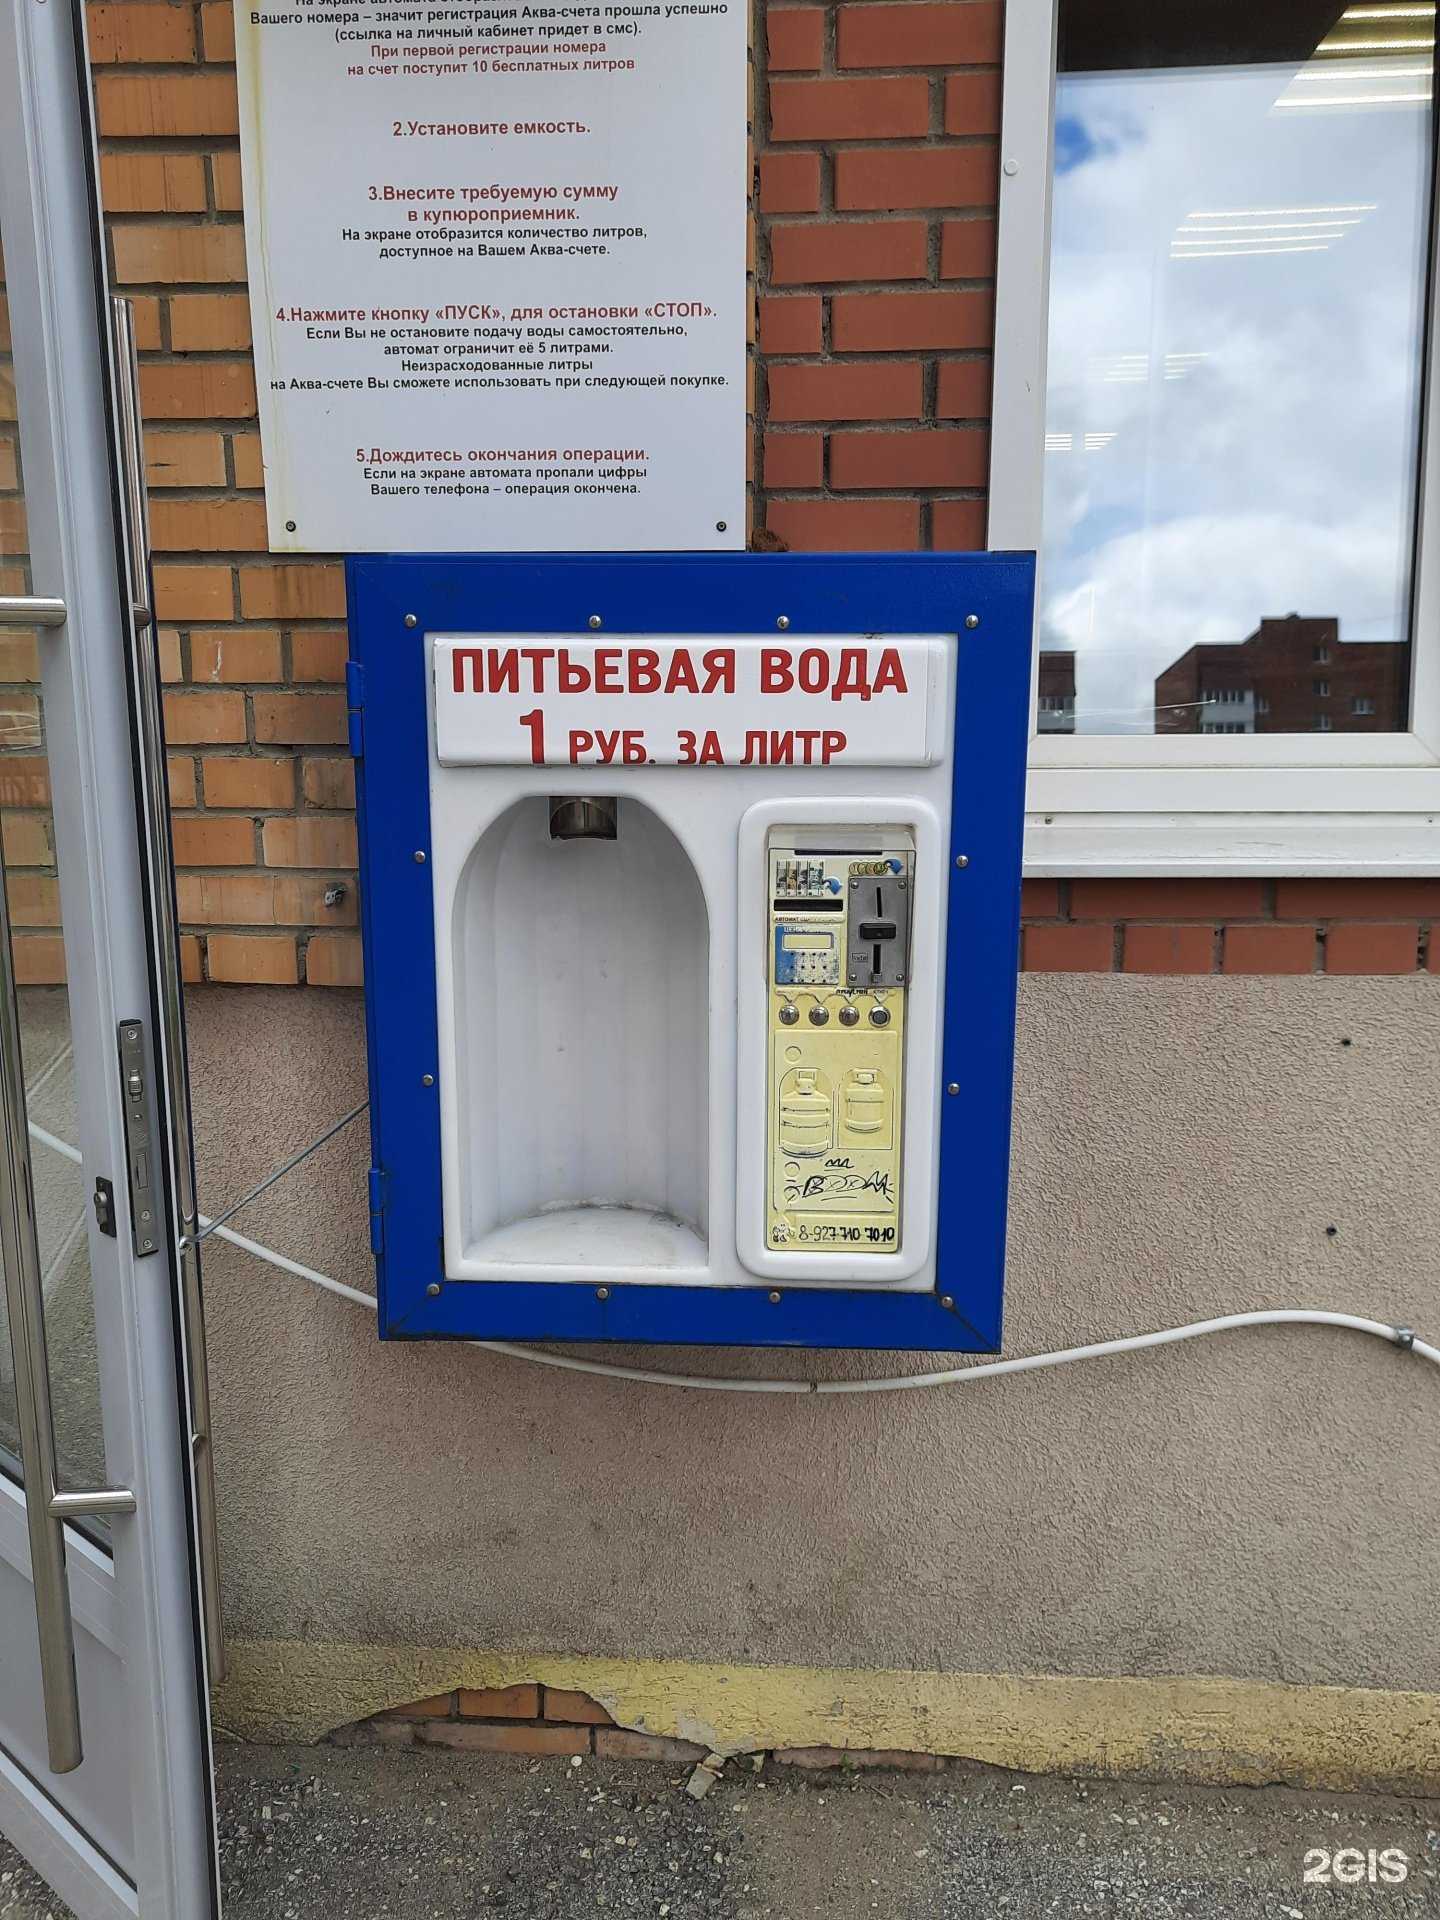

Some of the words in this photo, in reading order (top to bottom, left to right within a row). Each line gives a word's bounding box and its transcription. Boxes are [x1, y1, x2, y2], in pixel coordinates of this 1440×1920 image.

[250, 11, 303, 25] Вашего
[307, 12, 360, 26] номера
[375, 11, 424, 22] значит
[427, 8, 517, 24] регистрация
[521, 5, 601, 19] Аква-счета
[604, 5, 661, 20] прошла
[664, 3, 728, 19] успешно
[334, 27, 392, 44] (ссылка
[396, 29, 413, 40] на
[416, 24, 473, 40] личный
[477, 23, 535, 38] кабинет
[538, 24, 590, 39] придет
[593, 24, 603, 35] в
[606, 20, 642, 38] смс).
[371, 44, 399, 61] При
[403, 43, 454, 60] первой
[458, 43, 549, 59] регистрации
[553, 42, 606, 56] номера
[347, 65, 364, 76] на
[367, 64, 399, 76] счет
[402, 63, 468, 77] поступит
[472, 59, 488, 73] 10
[491, 59, 579, 73] бесплатных
[582, 59, 635, 73] литров
[392, 120, 509, 137] 2.Установите
[513, 121, 591, 135] емкость.
[368, 185, 456, 201] 3.Внесите
[459, 183, 558, 204] требуемую
[562, 185, 619, 202] сумму
[407, 210, 418, 222] в
[423, 208, 580, 226] купюроприемник.
[342, 228, 361, 241] На
[364, 230, 412, 244] экране
[415, 226, 504, 243] отобразится
[507, 228, 589, 240] количество
[592, 227, 647, 241] литров,
[378, 246, 454, 260] доступное
[457, 246, 474, 257] на
[477, 243, 526, 257] Вашем
[529, 243, 611, 256] Аква-счете.
[275, 306, 367, 322] 4.Нажмите
[371, 306, 430, 324] кнопку
[435, 304, 506, 322] «ПУСК»,
[510, 307, 543, 322] для
[548, 306, 639, 319] остановки
[644, 302, 717, 318] «СТОП».
[306, 327, 341, 340] Если
[344, 326, 367, 339] Вы
[370, 328, 387, 339] не
[390, 328, 470, 339] остановите
[473, 327, 523, 340] подачу
[526, 327, 565, 339] воды
[568, 325, 688, 337] самостоятельно,
[383, 345, 440, 356] автомат
[443, 344, 515, 358] ограничит
[518, 341, 535, 354] её
[538, 341, 546, 354] 5
[549, 343, 614, 357] литрами.
[401, 359, 545, 374] Неизрасходованные
[547, 360, 593, 373] литры
[270, 380, 286, 391] на
[289, 377, 364, 390] Аква-счете
[367, 376, 389, 389] Вы
[392, 378, 451, 389] сможете
[454, 377, 552, 388] использовать
[555, 377, 581, 390] при
[584, 373, 666, 390] следующей
[670, 375, 729, 389] покупке.
[356, 447, 463, 465] 5.Дождитесь
[467, 449, 558, 462] окончания
[562, 449, 650, 464] операции.
[363, 467, 397, 480] Если
[400, 469, 417, 479] на
[420, 469, 466, 482] экране
[469, 468, 532, 481] автомата
[535, 468, 594, 481] пропали
[598, 465, 647, 481] цифры
[370, 483, 421, 496] Вашего
[423, 482, 490, 497] телефона
[504, 484, 570, 497] операция
[573, 484, 641, 494] окончена.
[451, 648, 737, 694] ПИТЬЕВАЯ
[759, 648, 909, 702] ВОДА
[518, 708, 546, 765] 1
[568, 730, 657, 765] РУБ.
[677, 730, 725, 765] ЗА
[739, 730, 848, 765] ЛИТР
